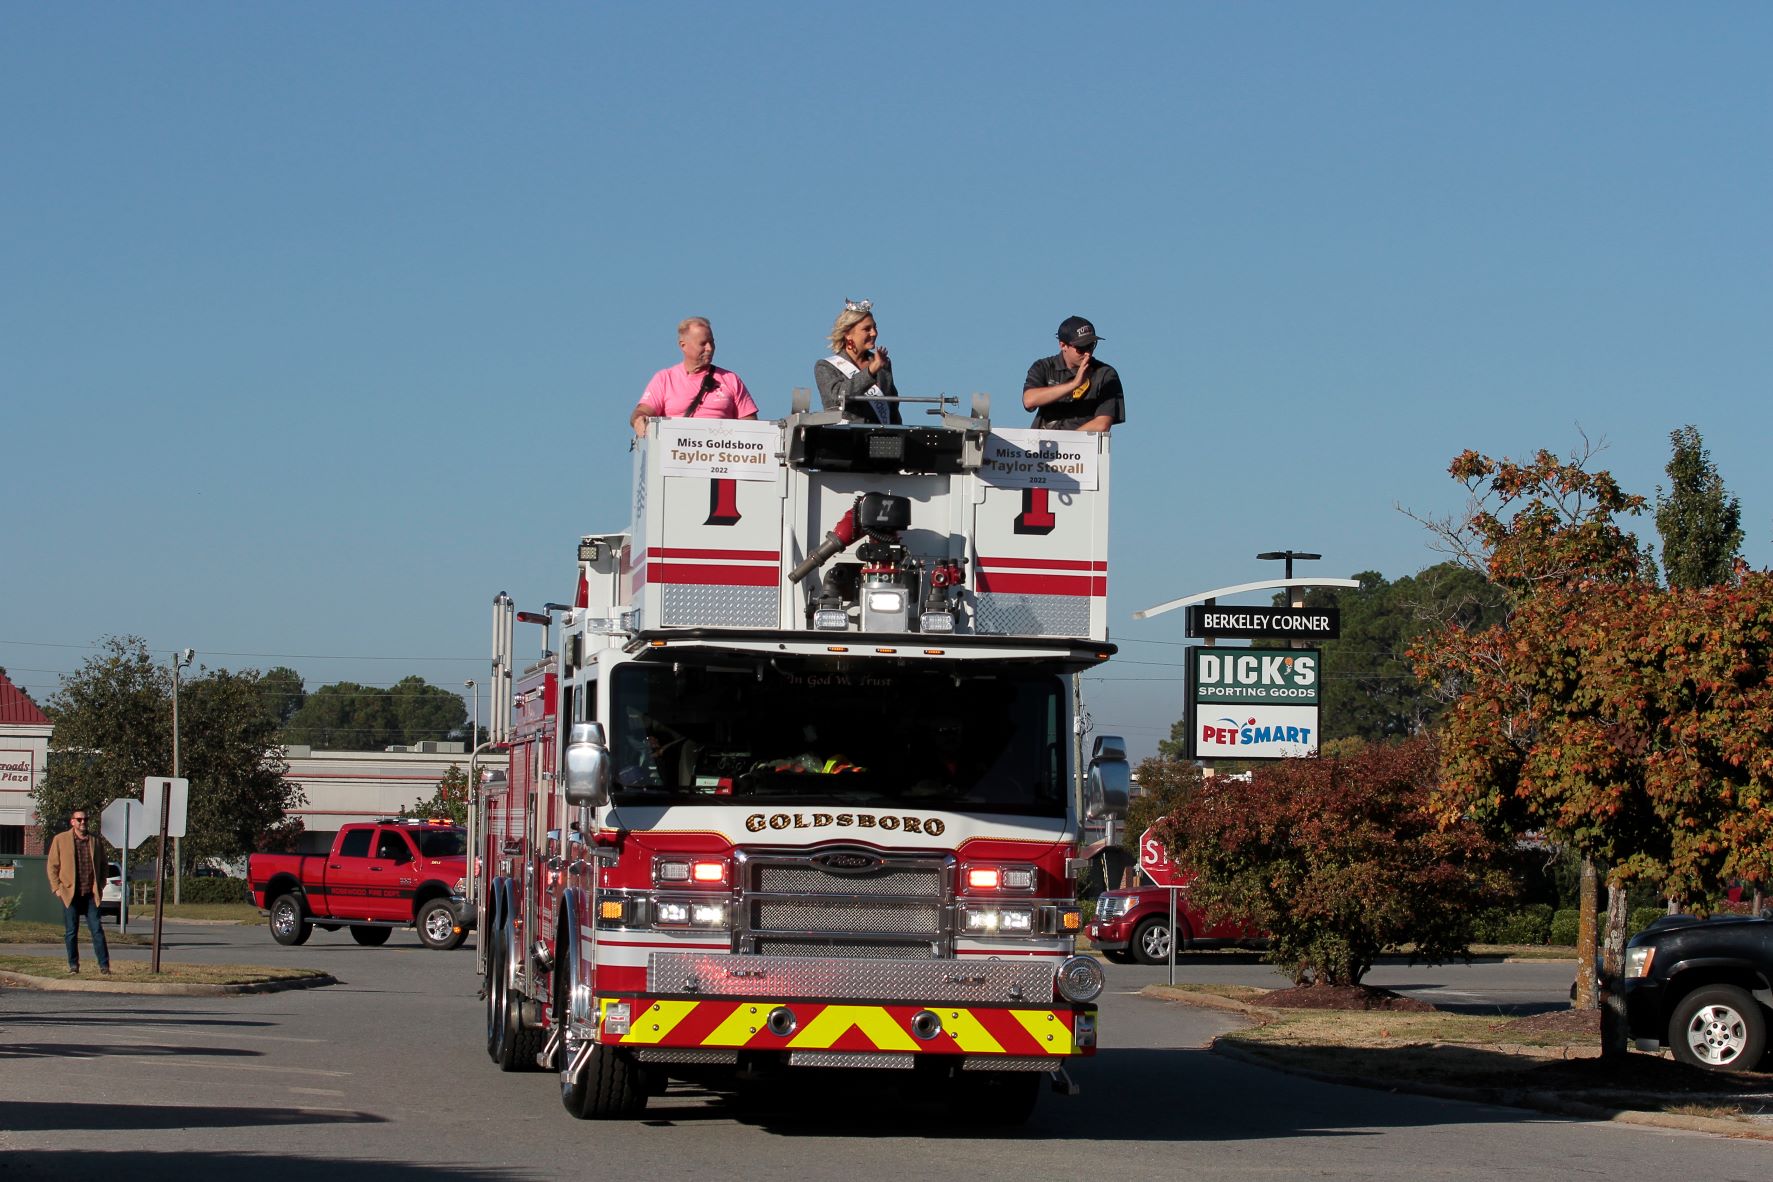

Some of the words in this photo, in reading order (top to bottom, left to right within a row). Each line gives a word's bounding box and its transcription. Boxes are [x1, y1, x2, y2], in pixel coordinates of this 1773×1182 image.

[677, 438, 703, 448] Miss
[706, 439, 764, 450] Goldsboro
[671, 449, 715, 464] Taylor
[718, 452, 766, 464] Stovall
[996, 448, 1022, 458] Miss
[1025, 450, 1081, 461] Goldsboro
[710, 466, 728, 474] 2022
[991, 460, 1034, 474] Taylor
[1036, 462, 1084, 474] Stovall
[1204, 613, 1270, 629] BERKELEY
[1272, 615, 1330, 631] CORNER
[1199, 654, 1315, 686] DICK'S
[1198, 687, 1266, 697] SPORTING
[1270, 688, 1316, 697] GOODS
[1202, 724, 1311, 746] PETSMART
[2, 772, 29, 782] Plaza
[745, 813, 946, 837] GOLDSBORO
